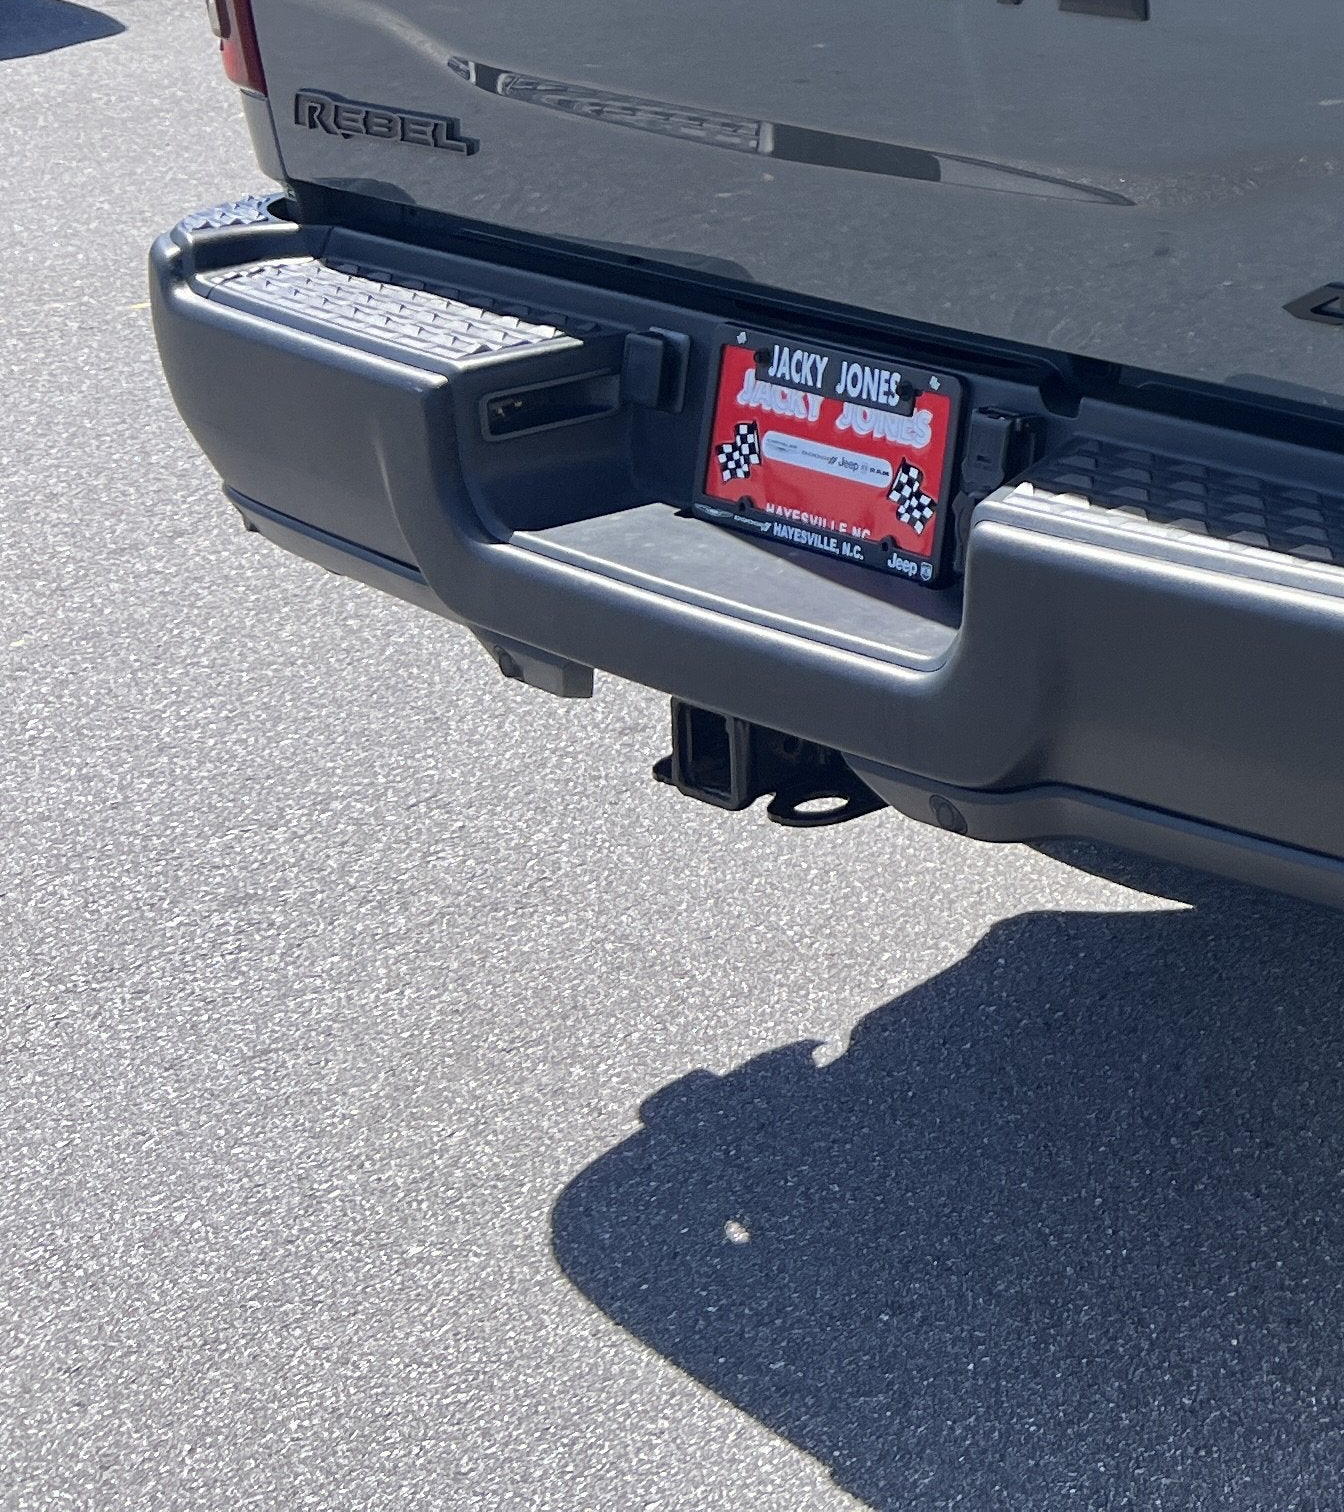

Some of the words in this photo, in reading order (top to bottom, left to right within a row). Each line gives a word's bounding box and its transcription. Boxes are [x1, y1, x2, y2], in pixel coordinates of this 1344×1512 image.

[294, 88, 479, 156] REBEL
[768, 345, 828, 388] JACKY
[835, 362, 901, 407] JONES
[838, 457, 859, 472] Jeep
[887, 553, 918, 577] Jeep
